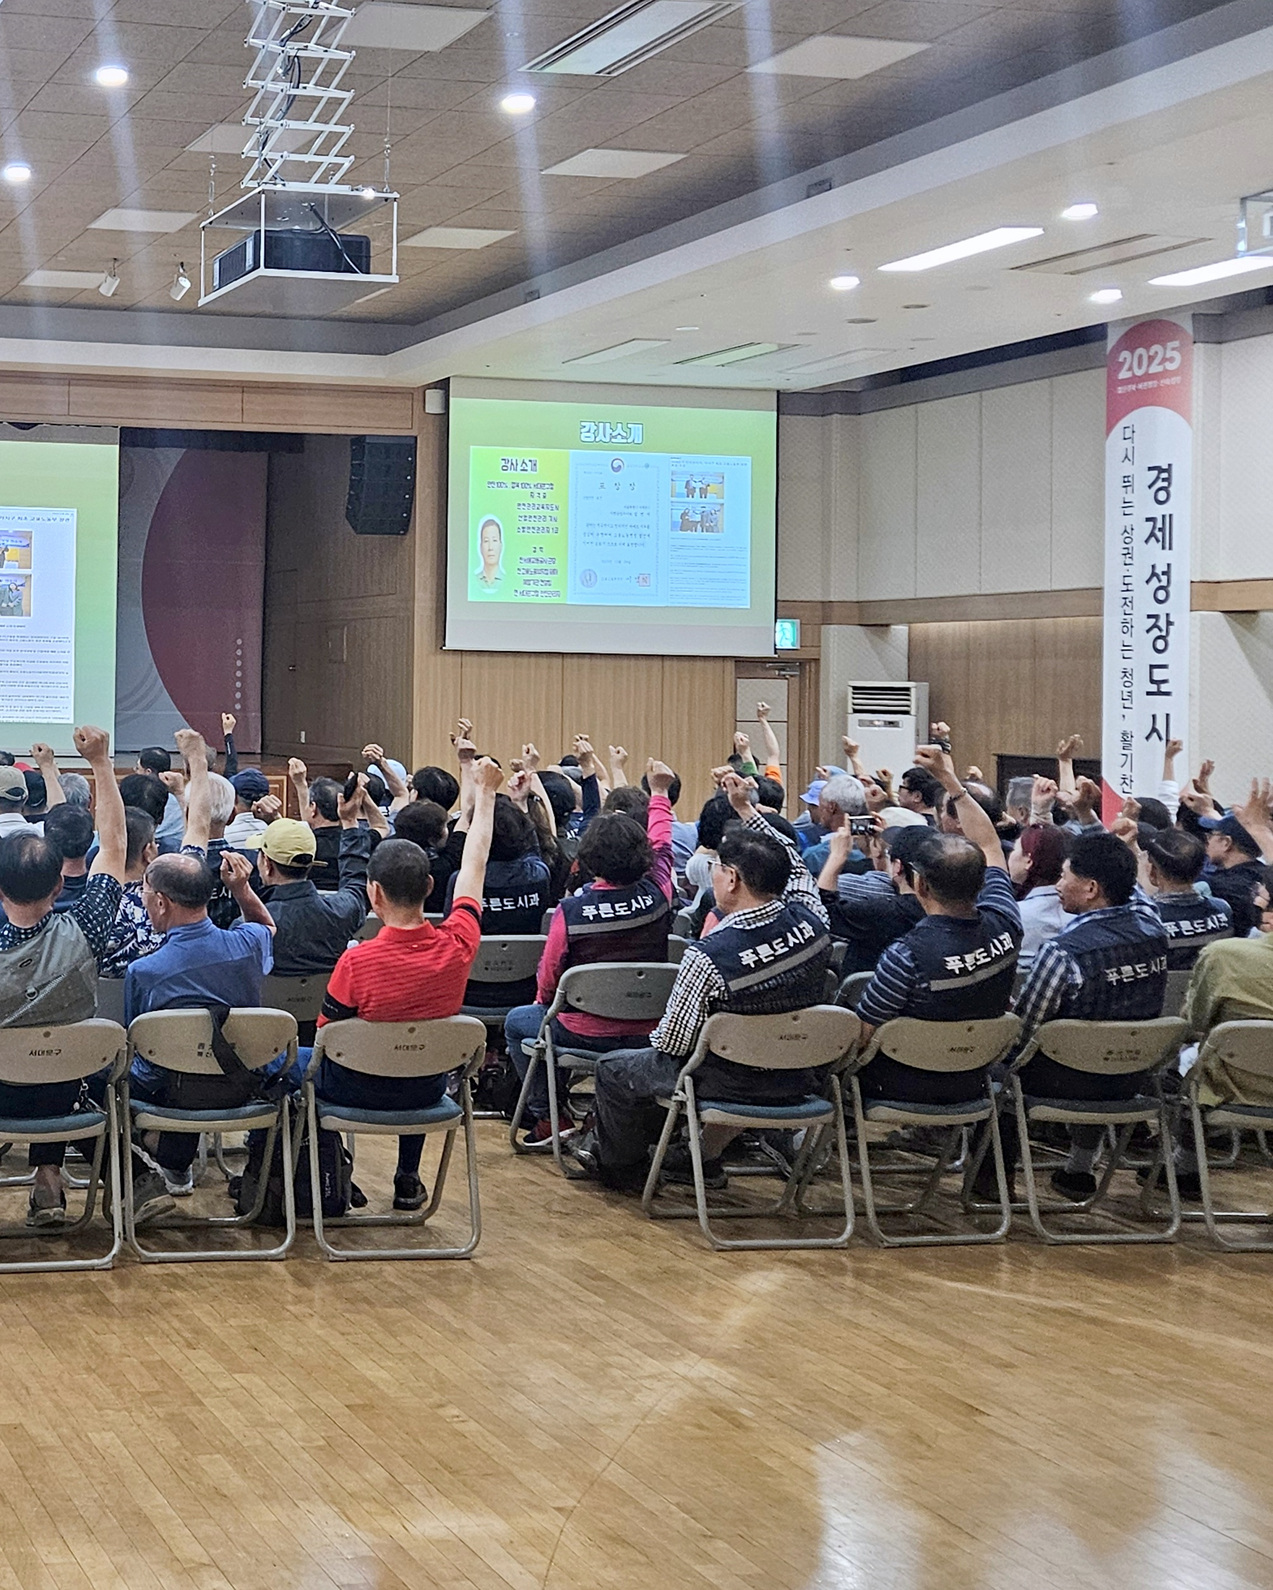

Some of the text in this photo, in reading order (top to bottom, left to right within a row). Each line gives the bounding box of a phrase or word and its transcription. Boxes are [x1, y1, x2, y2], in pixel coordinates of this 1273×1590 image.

[1117, 340, 1183, 380] 2025
[579, 420, 644, 445] 강사소개
[1121, 423, 1136, 466] 다시
[1120, 473, 1135, 517] 뛰는
[1143, 462, 1176, 749] 경제성장도시
[581, 894, 654, 921] 푸른도시과
[737, 919, 816, 969] 푸른도시과
[943, 931, 1015, 975] 푸른도시과
